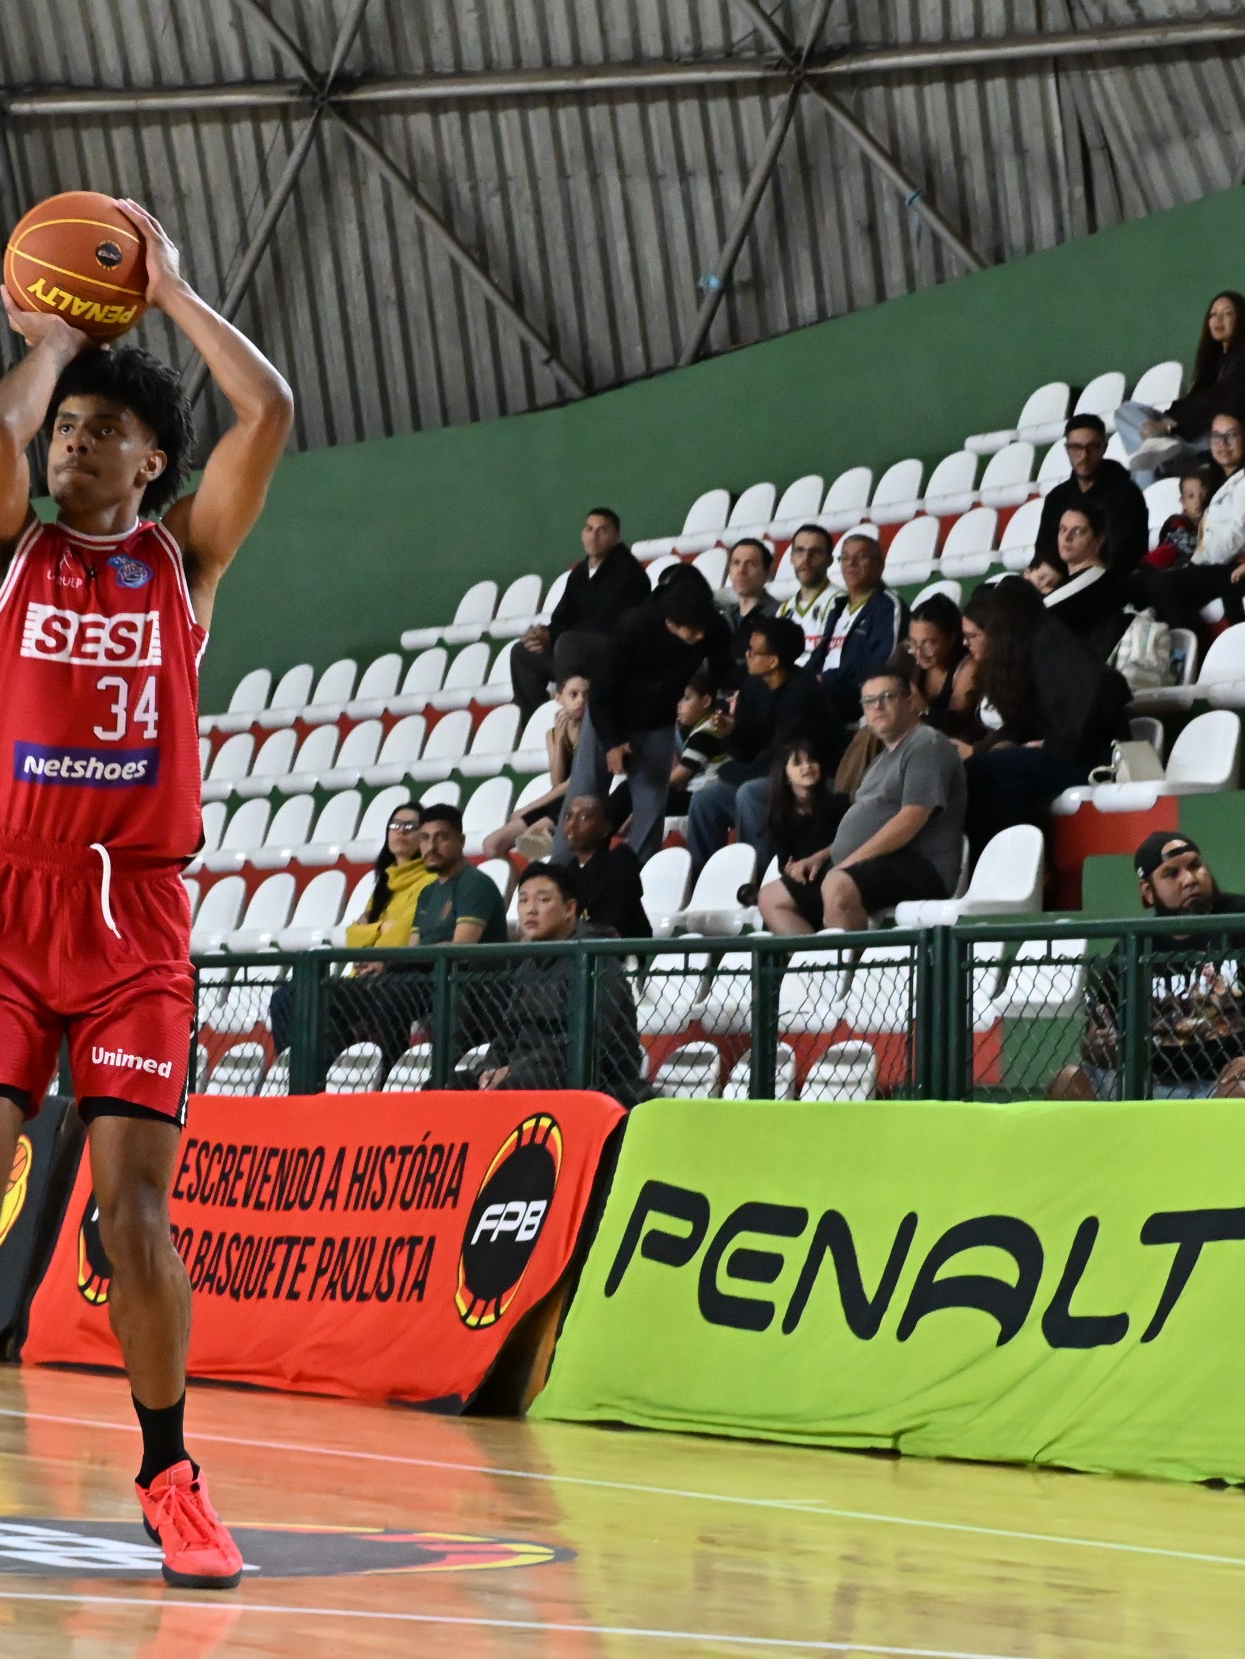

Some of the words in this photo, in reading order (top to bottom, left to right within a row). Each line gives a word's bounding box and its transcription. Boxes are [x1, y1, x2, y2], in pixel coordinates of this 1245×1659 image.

[27, 278, 139, 323] PENALTY
[35, 613, 155, 662] SESI
[93, 675, 159, 741] 34
[23, 755, 148, 780] Netshoes
[92, 1046, 172, 1078] Unimed
[172, 1138, 326, 1211] ESCREVENDO
[319, 1146, 346, 1211] A
[343, 1131, 469, 1211] HISTÓRIA
[470, 1199, 548, 1246] FPB
[192, 1230, 316, 1302] BASQUETE
[309, 1235, 436, 1301] PAULISTA
[604, 1179, 1245, 1350] PENALT
